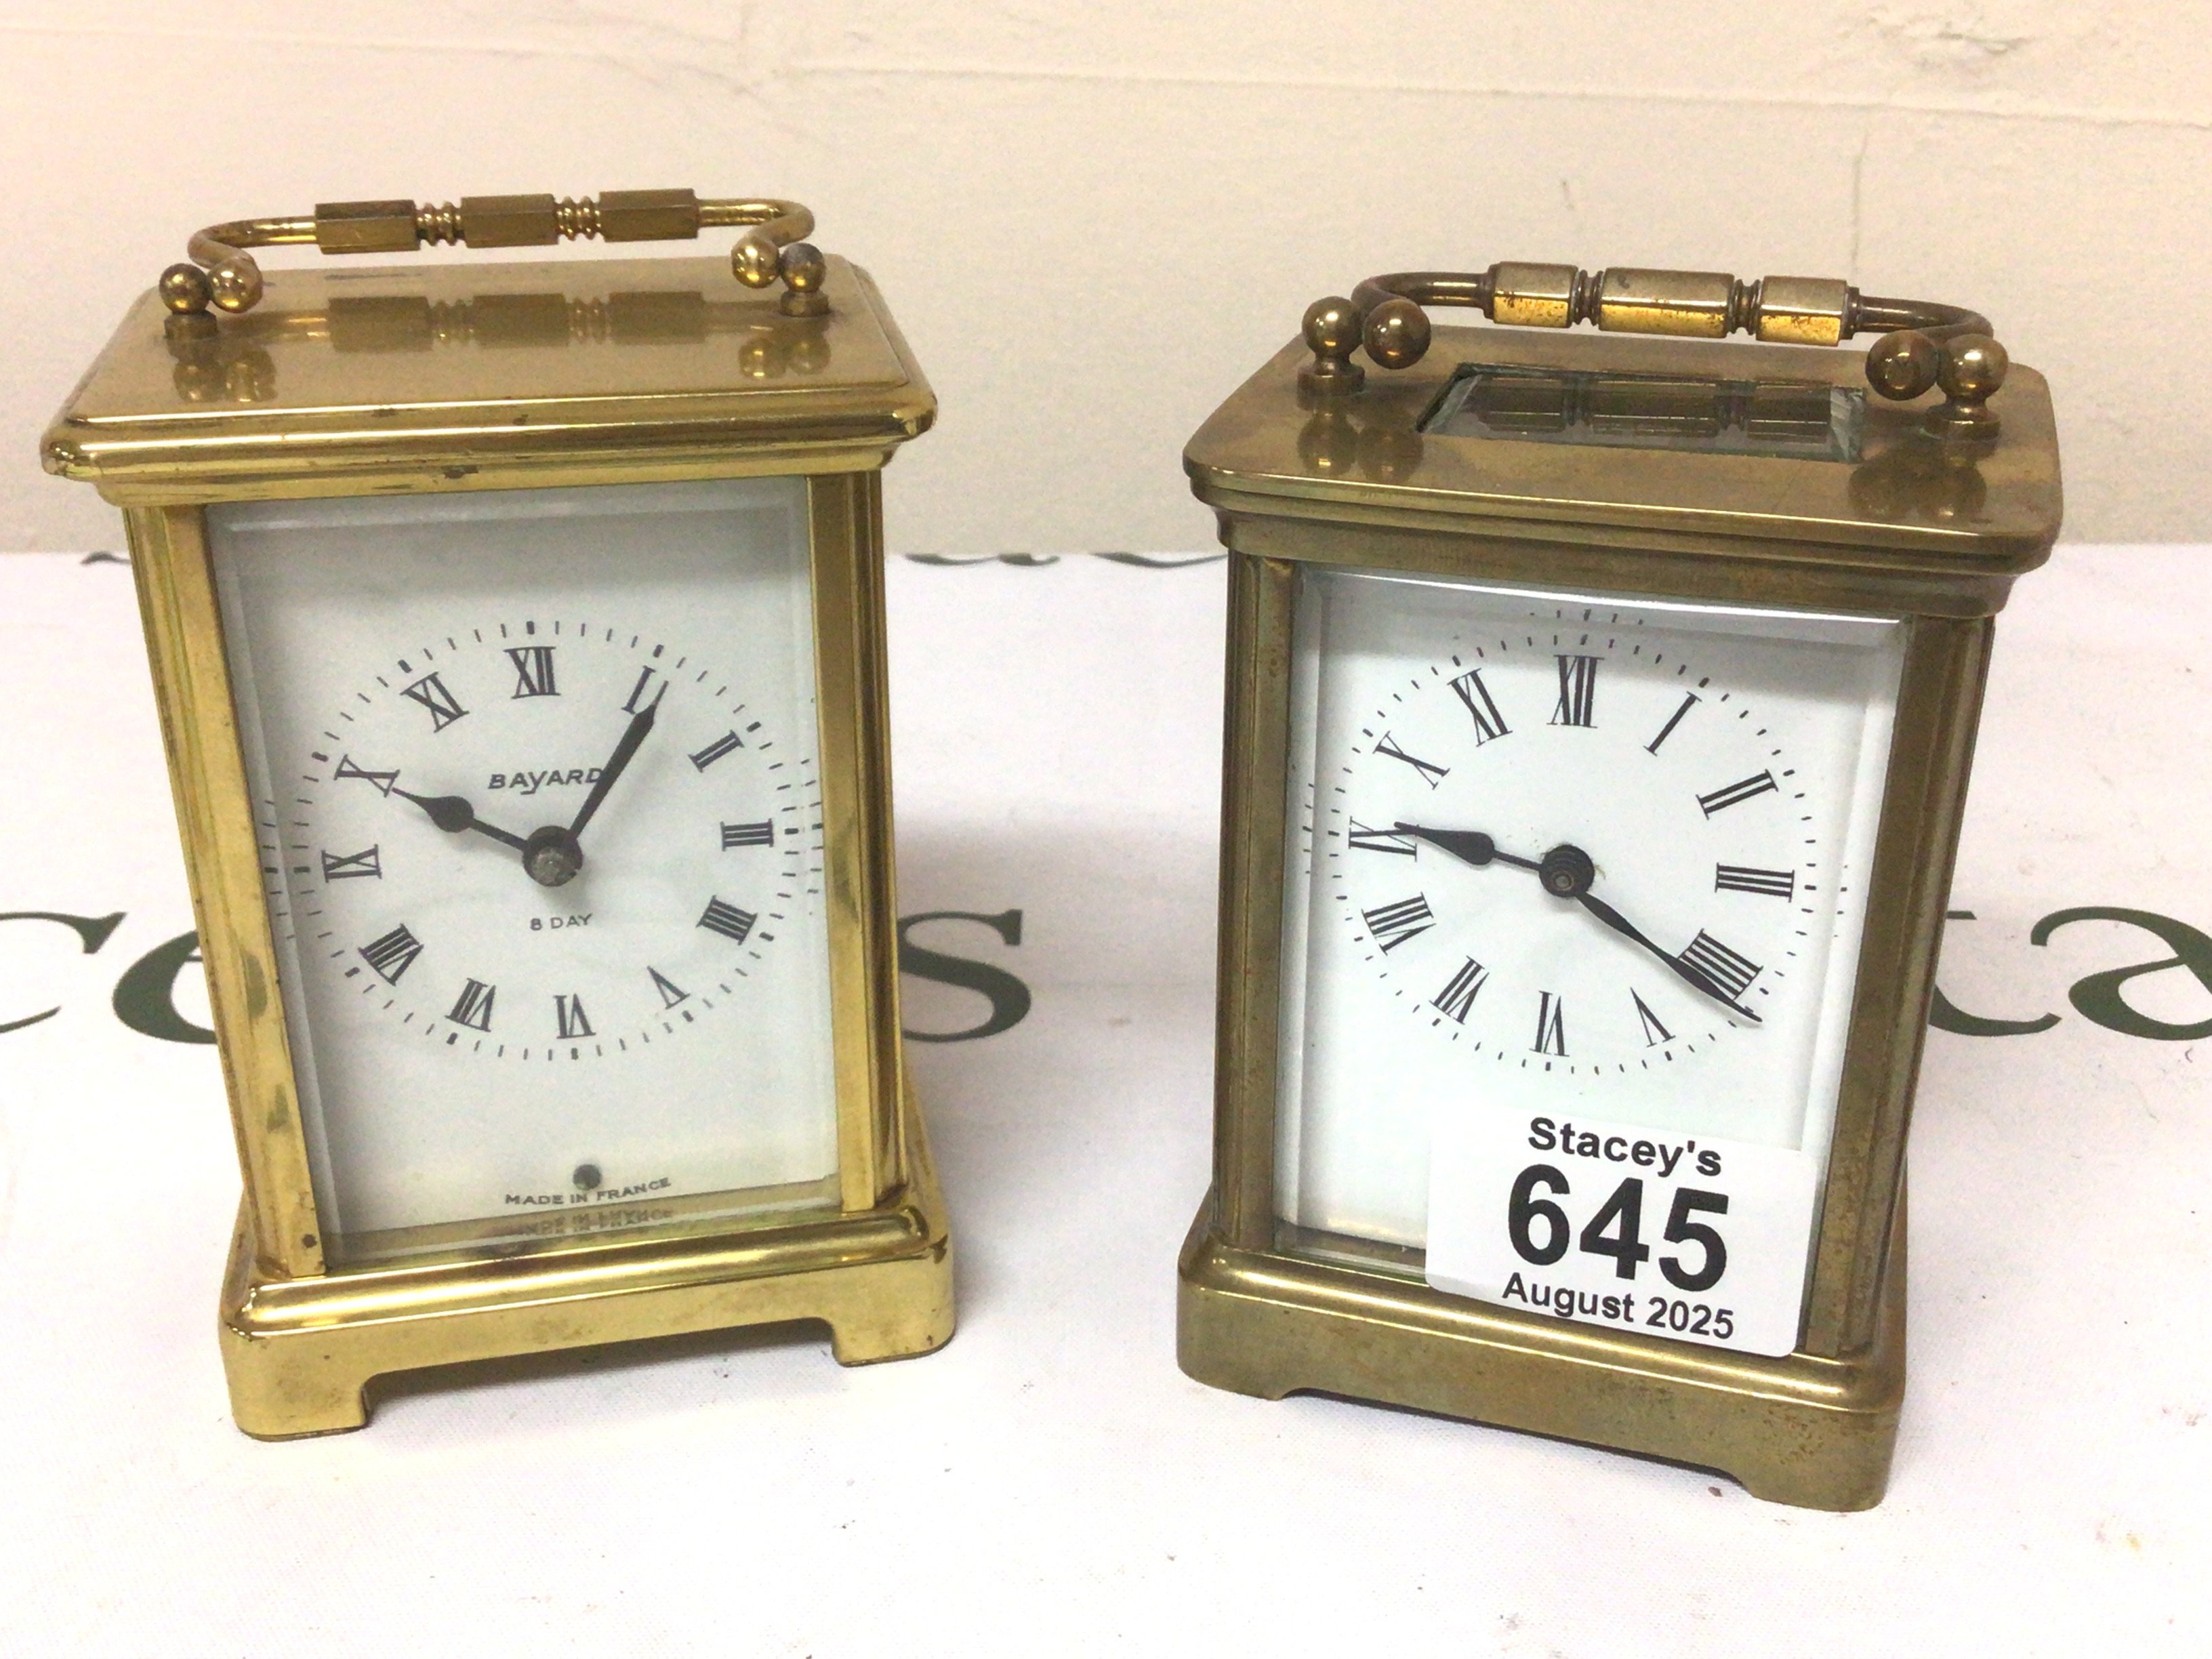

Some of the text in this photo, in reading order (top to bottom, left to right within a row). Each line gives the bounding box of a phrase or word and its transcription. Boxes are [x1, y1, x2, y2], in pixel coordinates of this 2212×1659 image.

[504, 645, 561, 699] XII
[1546, 655, 1605, 729] XII
[400, 671, 470, 733] XI
[1446, 668, 1513, 747] XI
[333, 754, 400, 798] X
[687, 730, 744, 773] II
[1372, 731, 1450, 790] X
[487, 768, 602, 796] BAYARD
[1696, 769, 1779, 821] II
[720, 818, 774, 852] III
[1348, 815, 1418, 862] IX
[321, 844, 382, 882] IX
[1715, 862, 1795, 903] III
[530, 913, 593, 931] 8 DAY
[696, 895, 758, 945] IIII
[1361, 891, 1437, 956] VIII
[357, 923, 424, 986] VIII
[1677, 928, 1764, 1001] IIII
[445, 977, 496, 1032] VII
[647, 965, 691, 1009] V
[1429, 956, 1490, 1025] VII
[553, 993, 597, 1039] VI
[1529, 990, 1570, 1057] VI
[1630, 987, 1677, 1048] V
[1528, 1117, 1722, 1178] Stacey's
[504, 1176, 672, 1206] MADE IN FRANCE
[1508, 1164, 1729, 1292] 645
[1501, 1272, 1734, 1339] August 2025
